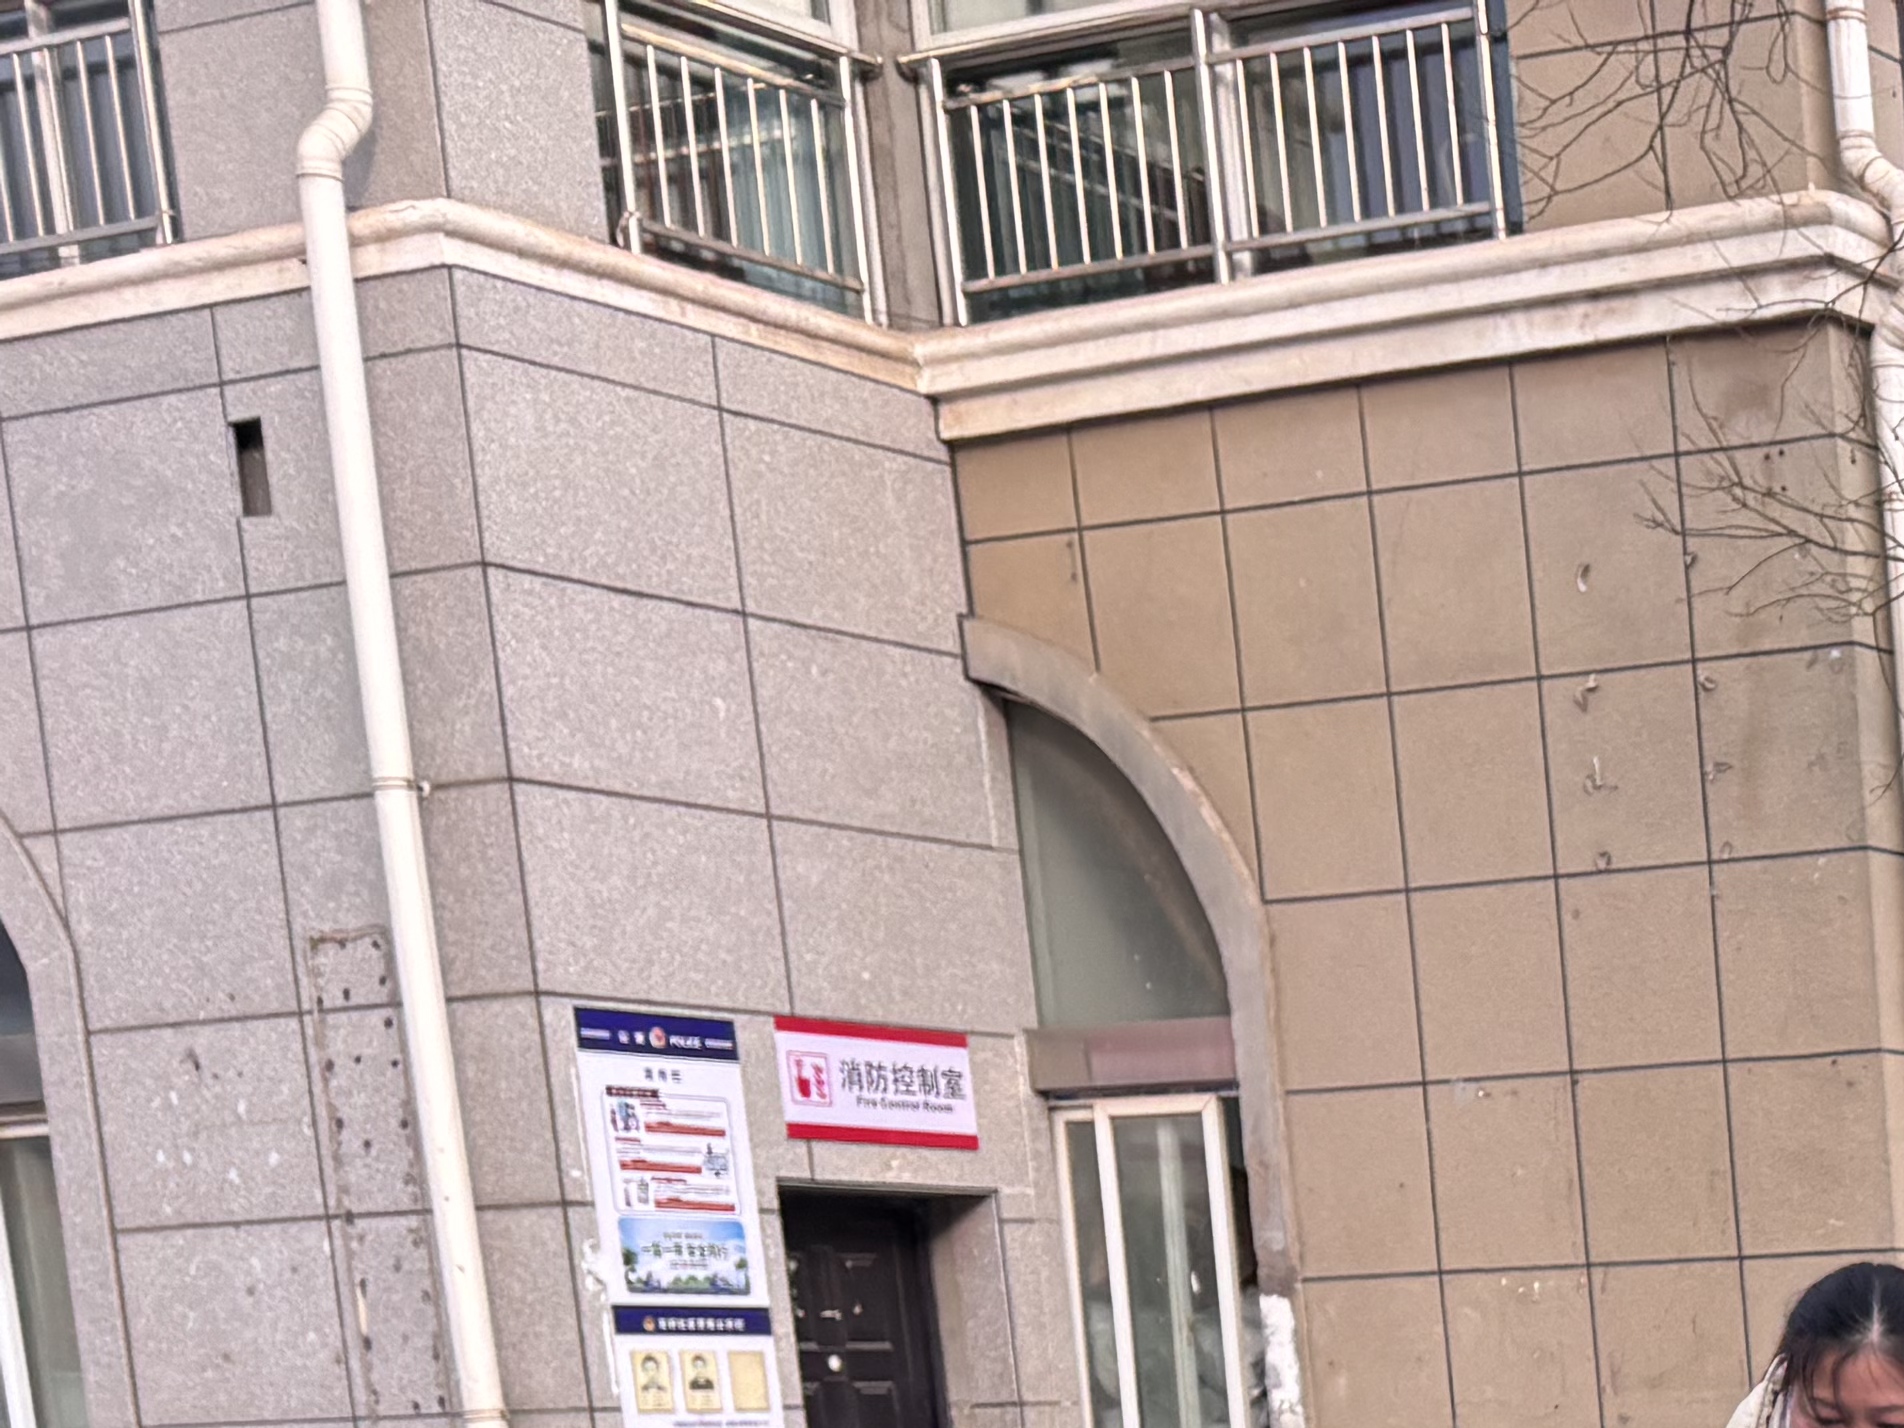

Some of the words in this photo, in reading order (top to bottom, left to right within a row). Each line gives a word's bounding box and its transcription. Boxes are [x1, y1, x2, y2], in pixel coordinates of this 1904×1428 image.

[839, 1058, 966, 1099] 消防控制室
[856, 1095, 878, 1109] Fire
[879, 1097, 920, 1111] Control
[922, 1100, 953, 1113] Room
